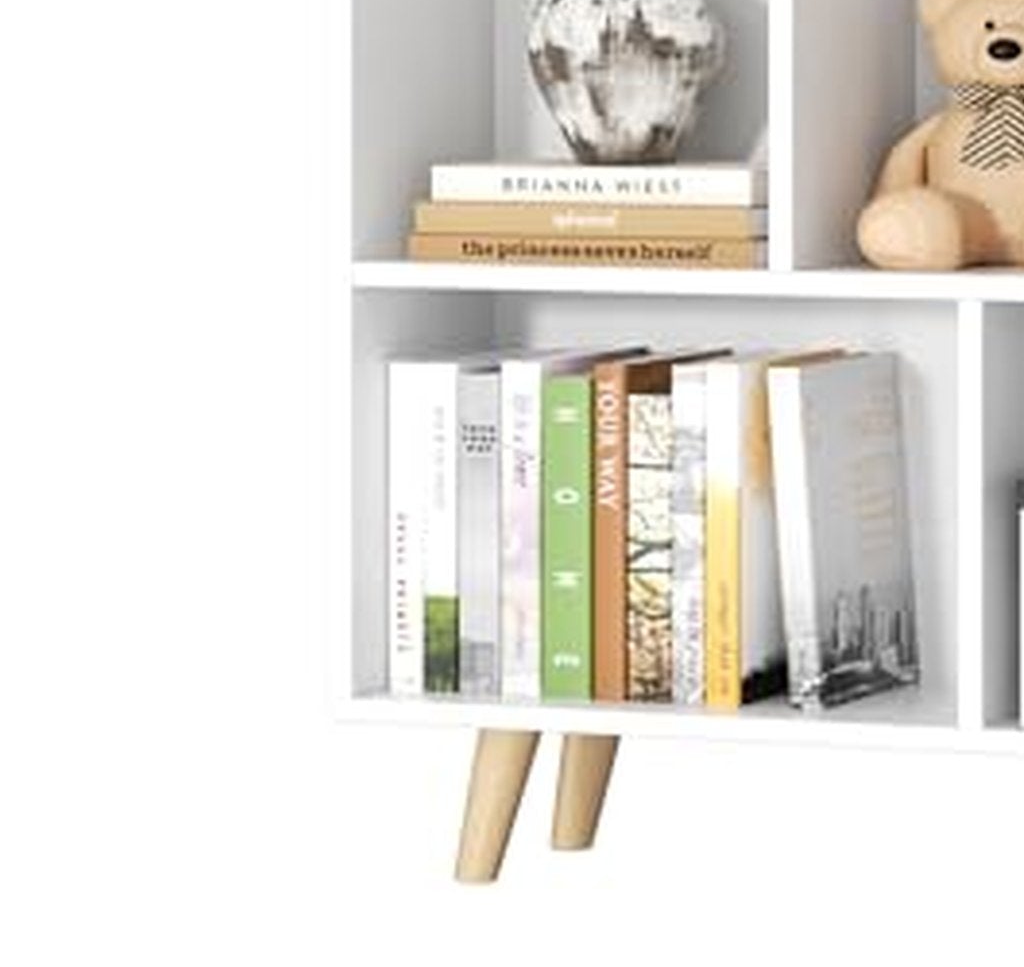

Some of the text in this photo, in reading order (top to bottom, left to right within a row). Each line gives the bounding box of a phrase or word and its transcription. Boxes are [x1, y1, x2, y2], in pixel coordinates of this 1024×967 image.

[502, 177, 604, 194] BRIANNA
[597, 379, 617, 512] YOUR WAY
